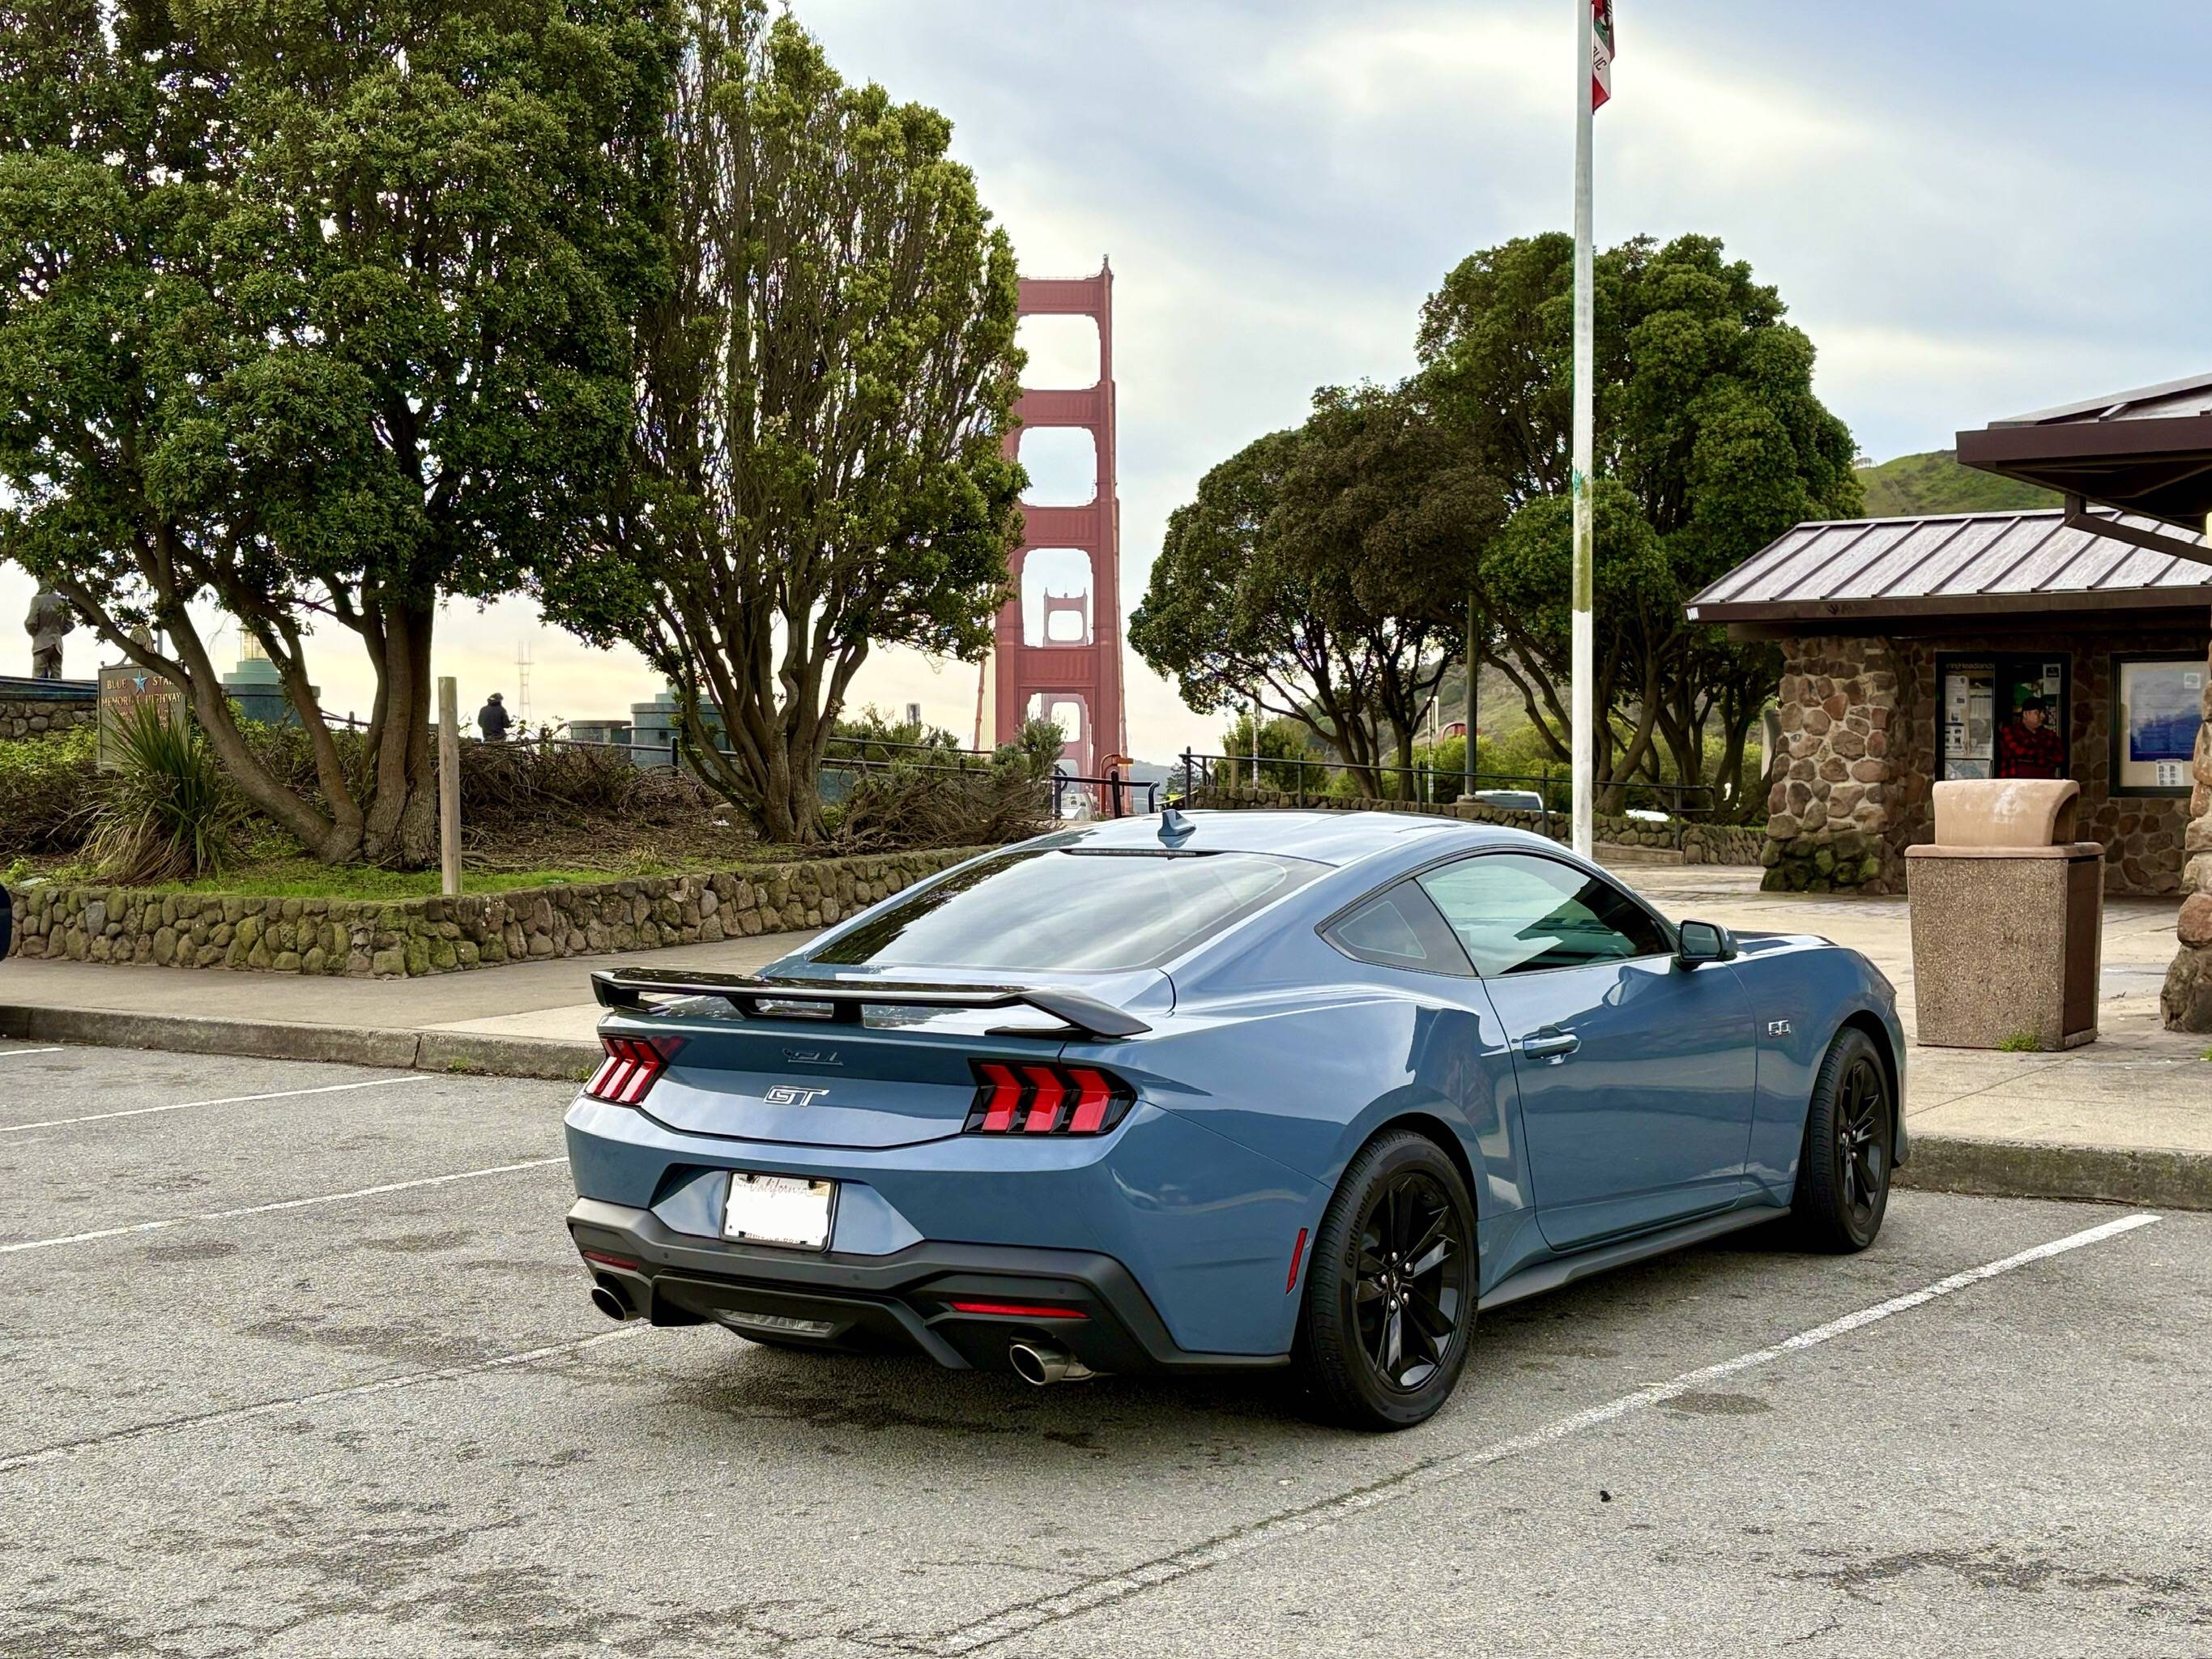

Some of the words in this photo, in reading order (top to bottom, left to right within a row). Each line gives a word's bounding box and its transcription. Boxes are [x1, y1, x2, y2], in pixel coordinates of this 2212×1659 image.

[107, 679, 126, 689] BLUE
[152, 676, 174, 686] STA
[101, 694, 141, 707] MEMORIL
[763, 1085, 830, 1107] GT
